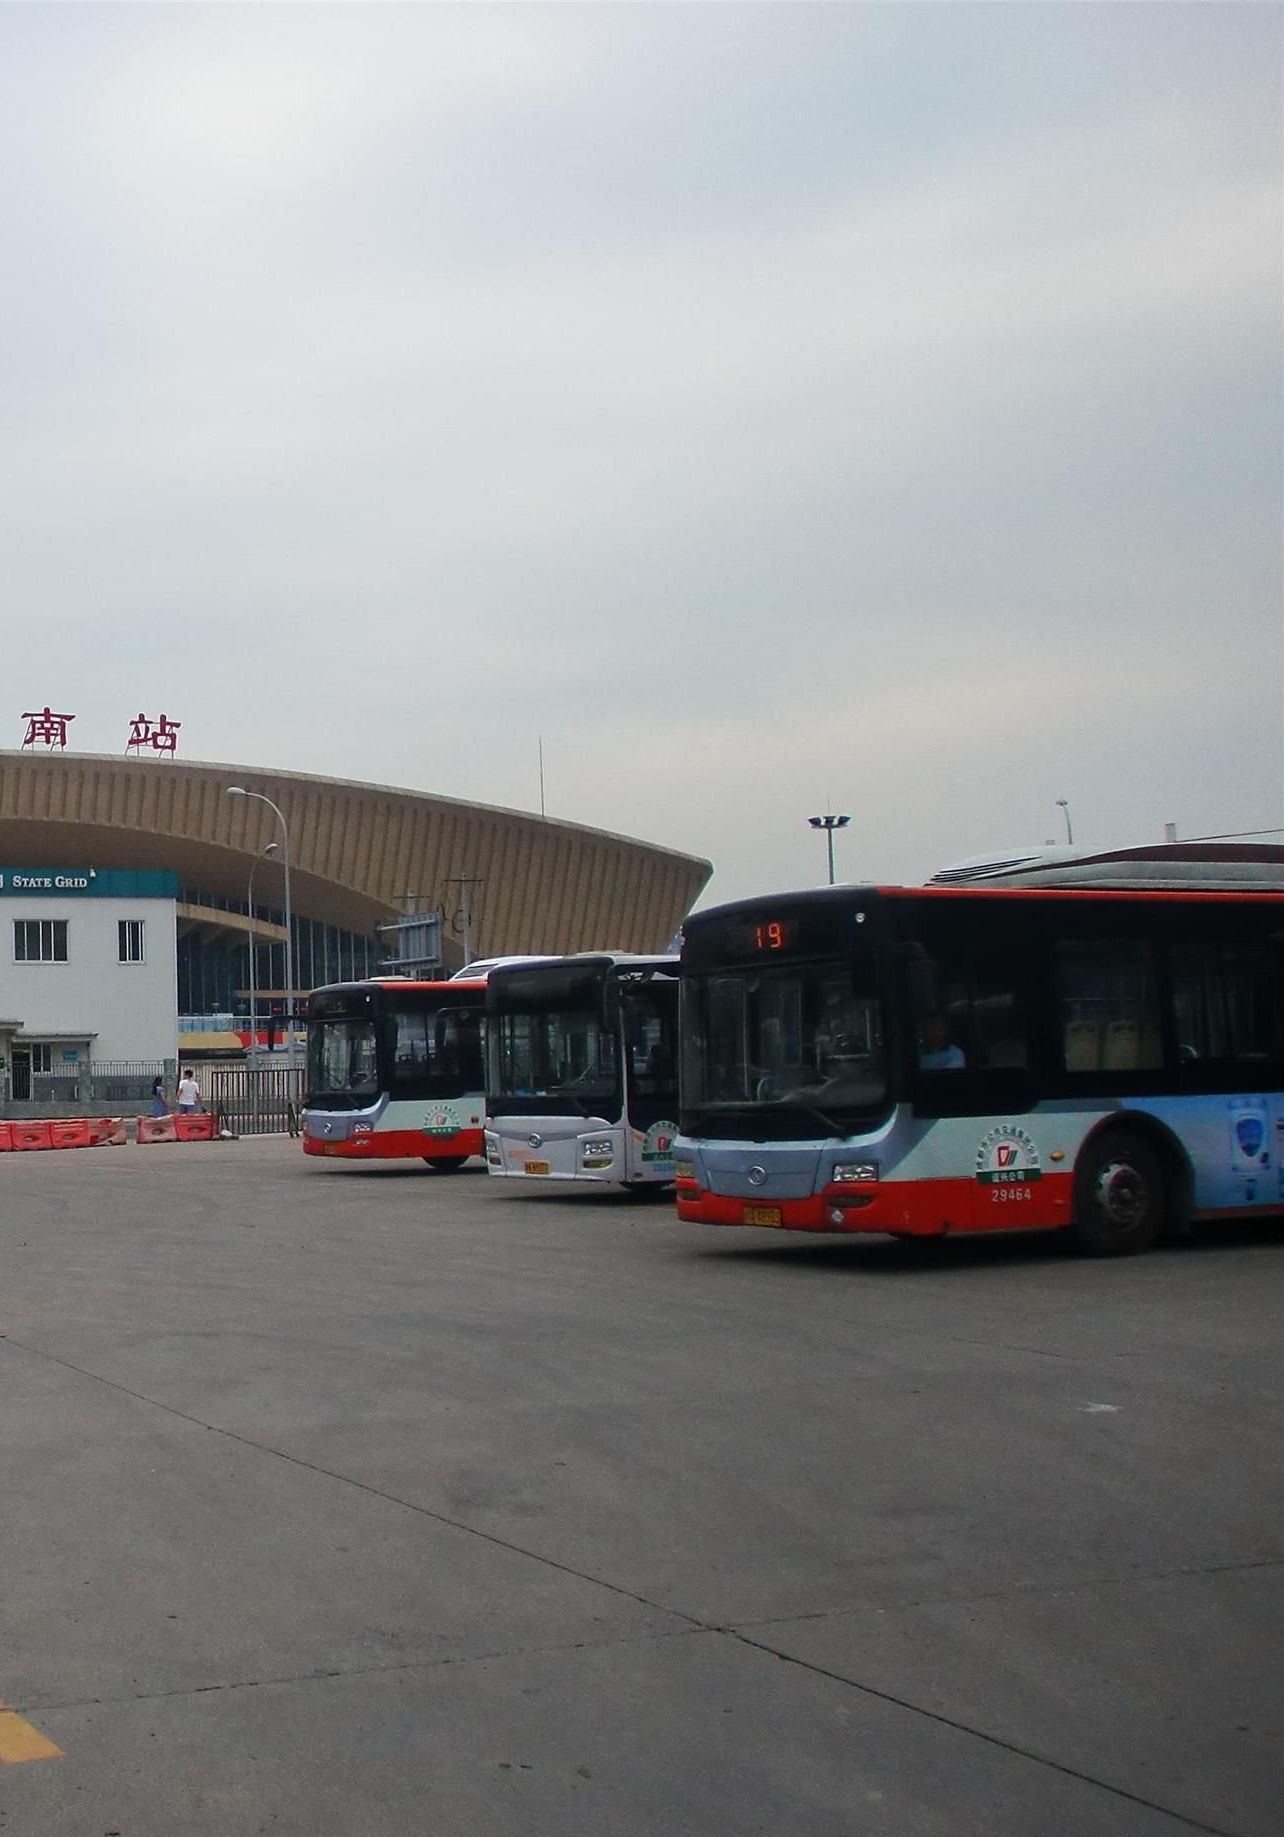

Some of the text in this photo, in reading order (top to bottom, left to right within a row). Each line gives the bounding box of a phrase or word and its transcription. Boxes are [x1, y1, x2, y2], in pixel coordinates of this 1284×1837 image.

[12, 875, 88, 889] STATE GRID
[756, 922, 782, 948] 19
[991, 1187, 1032, 1202] 29464
